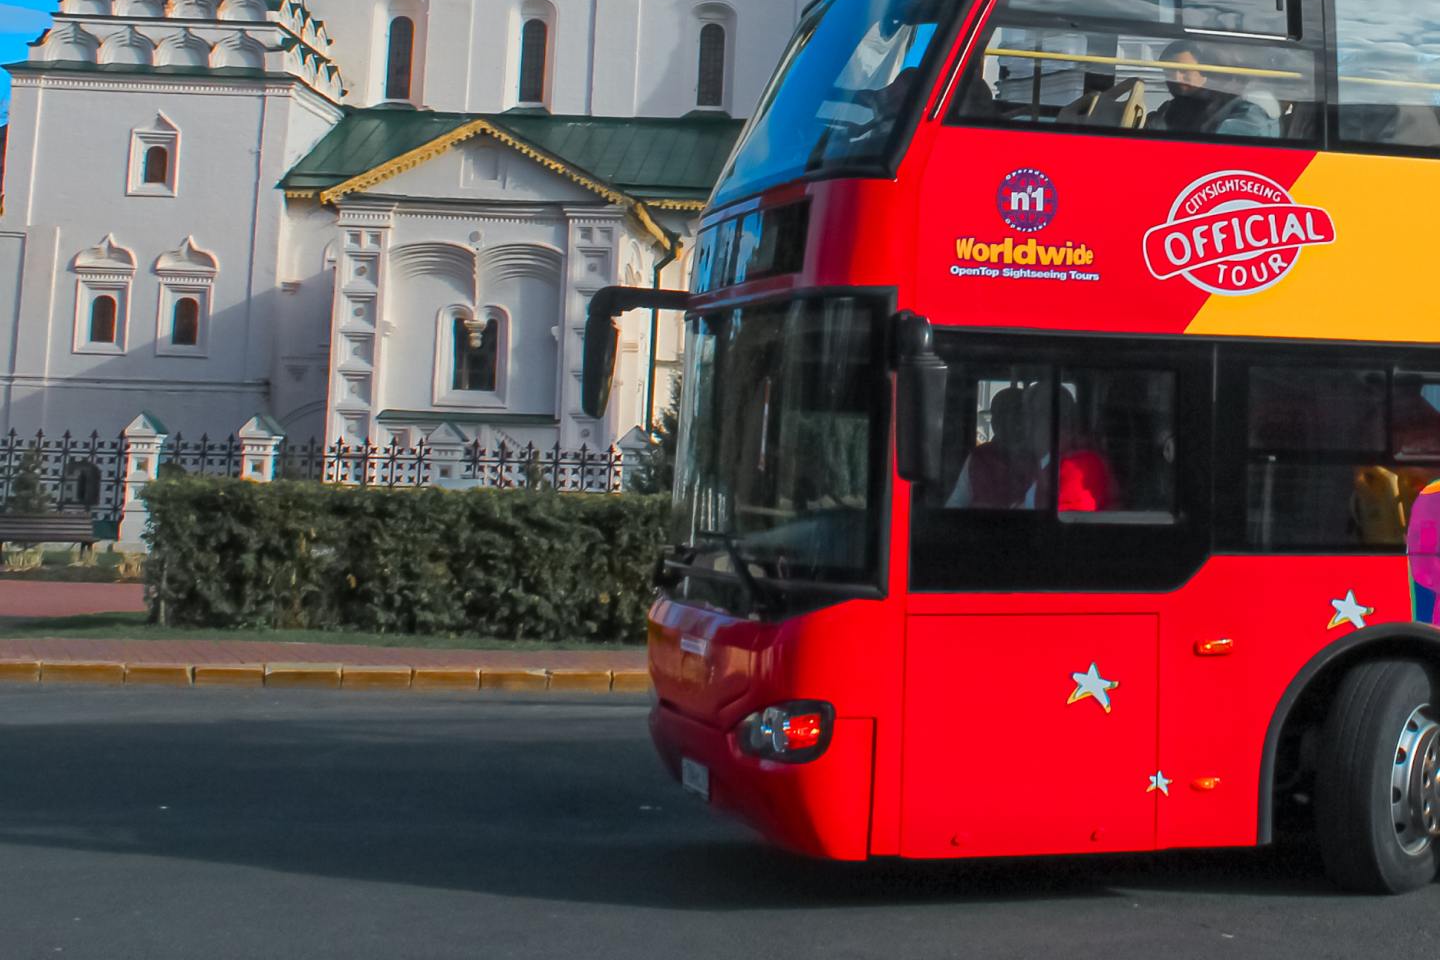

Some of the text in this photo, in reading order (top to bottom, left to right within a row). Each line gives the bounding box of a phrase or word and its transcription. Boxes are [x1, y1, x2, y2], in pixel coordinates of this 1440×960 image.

[1185, 179, 1282, 214] CITYSIGHTSEEING
[956, 237, 1094, 266] Worldwide
[1164, 211, 1325, 266] OFFICIAL
[950, 265, 1100, 282] OpenTop Sightseeing Tours
[1217, 253, 1288, 287] TOUR
